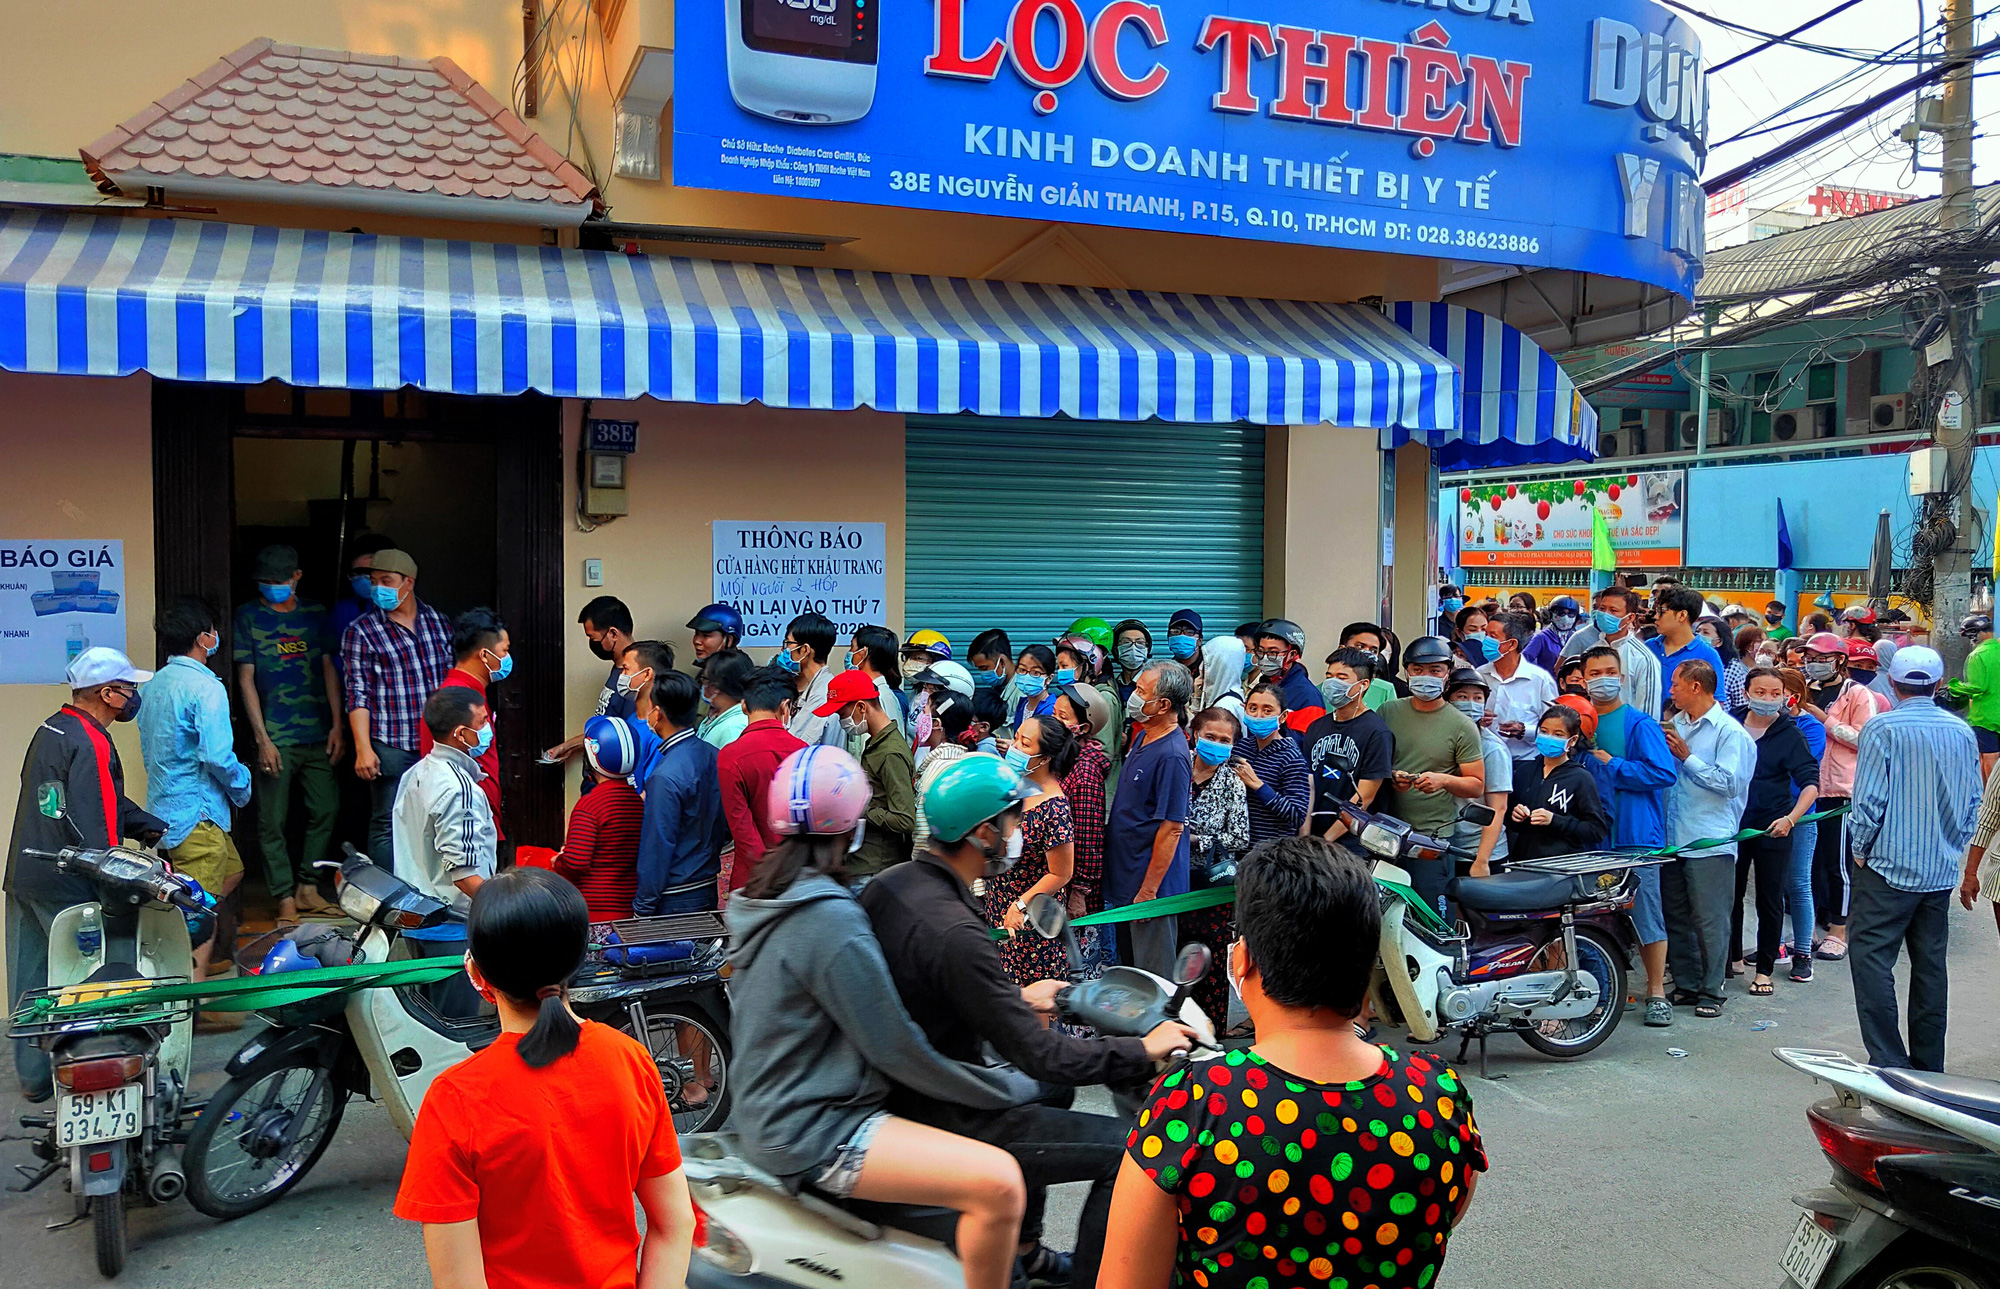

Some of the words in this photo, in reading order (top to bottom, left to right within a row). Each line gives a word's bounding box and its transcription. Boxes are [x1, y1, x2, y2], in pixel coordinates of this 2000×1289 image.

[810, 14, 837, 26] mg/dL
[924, 0, 1170, 115] LỌC
[1197, 15, 1532, 160] THIỆN
[1589, 16, 1708, 157] DỤN
[763, 143, 784, 154] Roche
[787, 145, 816, 157] Diabetes
[817, 148, 833, 159] Care
[964, 122, 1074, 164] KINH
[1091, 137, 1248, 183] DOANH
[1262, 150, 1364, 196] THIẾT
[1376, 171, 1410, 210] BỊ
[1422, 176, 1444, 204] Y
[1455, 169, 1498, 210] TẾ
[889, 170, 931, 192] 38E
[938, 173, 1034, 203] NGUYỄN
[1040, 182, 1098, 209] GIẢN
[1105, 191, 1186, 221] THANH,
[1192, 201, 1240, 226] P.15,
[1246, 207, 1299, 232] Q.10,
[1305, 213, 1376, 237] TP.HCM
[1384, 222, 1411, 240] ĐT:
[1417, 226, 1540, 254] 028.38623886
[598, 424, 634, 442] 38E
[737, 525, 814, 549] THÔNG
[820, 526, 862, 549] BÁO
[1, 545, 59, 568] BÁO
[68, 545, 114, 568] GIÁ
[716, 554, 742, 575] CỬA
[745, 555, 778, 575] HÀNG
[781, 555, 805, 575] HẾT
[808, 555, 841, 575] KHẨU
[843, 559, 882, 575] TRANG
[790, 578, 805, 594] 2
[760, 600, 786, 618] LẠI
[791, 596, 827, 615] VÀO
[832, 596, 867, 614] THỨ
[872, 600, 880, 614] 7
[4, 630, 30, 638] NHANH
[834, 622, 870, 635] 202
[72, 1089, 126, 1117] 59-K1
[63, 1112, 136, 1143] 334.79
[1786, 1245, 1815, 1285] 8004
